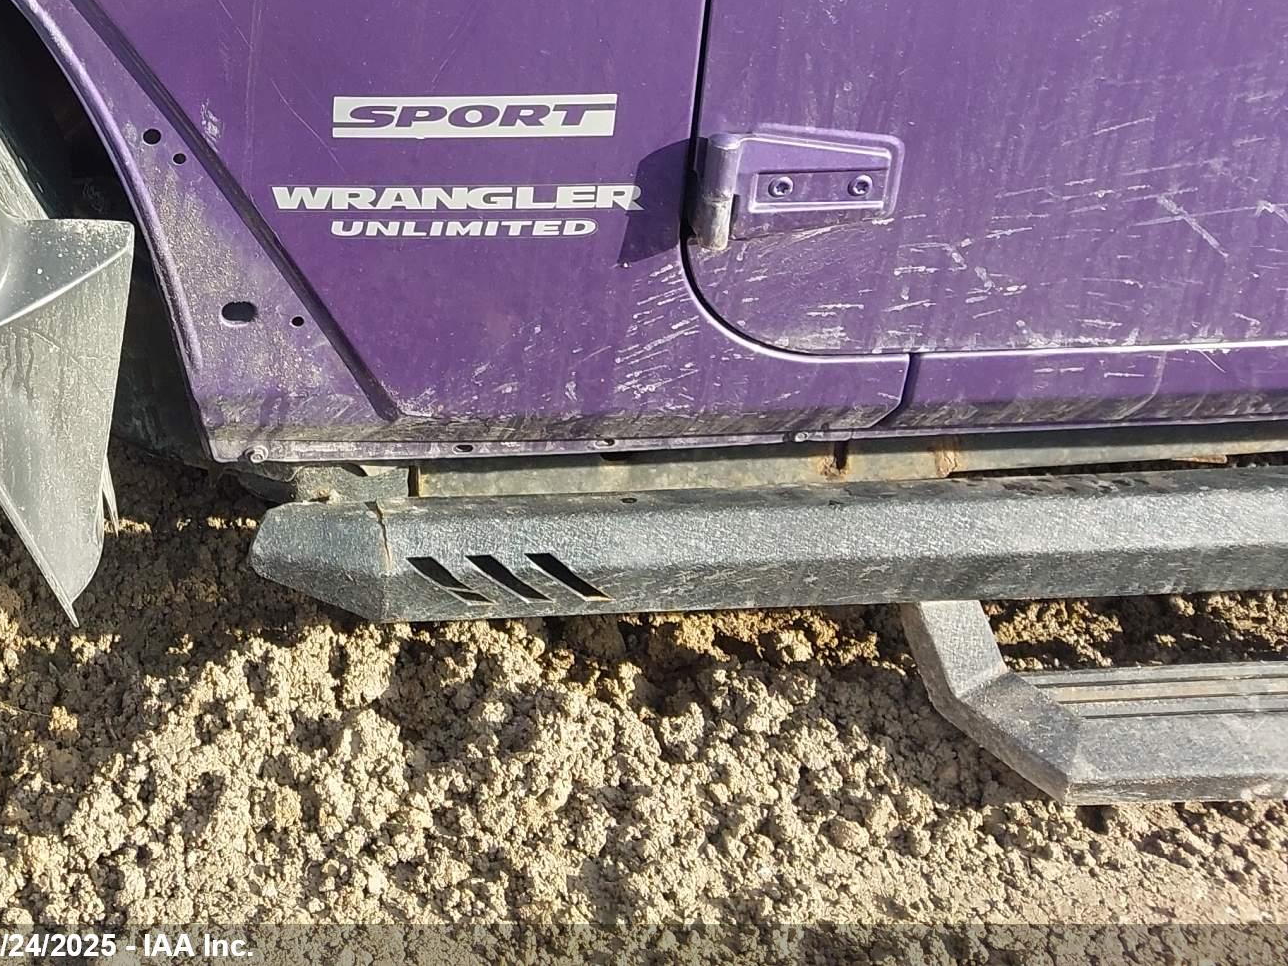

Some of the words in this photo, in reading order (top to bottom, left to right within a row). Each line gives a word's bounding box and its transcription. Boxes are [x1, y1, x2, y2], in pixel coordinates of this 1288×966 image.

[334, 100, 616, 131] SPORT
[272, 185, 643, 211] WRANGLER
[331, 219, 596, 237] UNLIMITED
